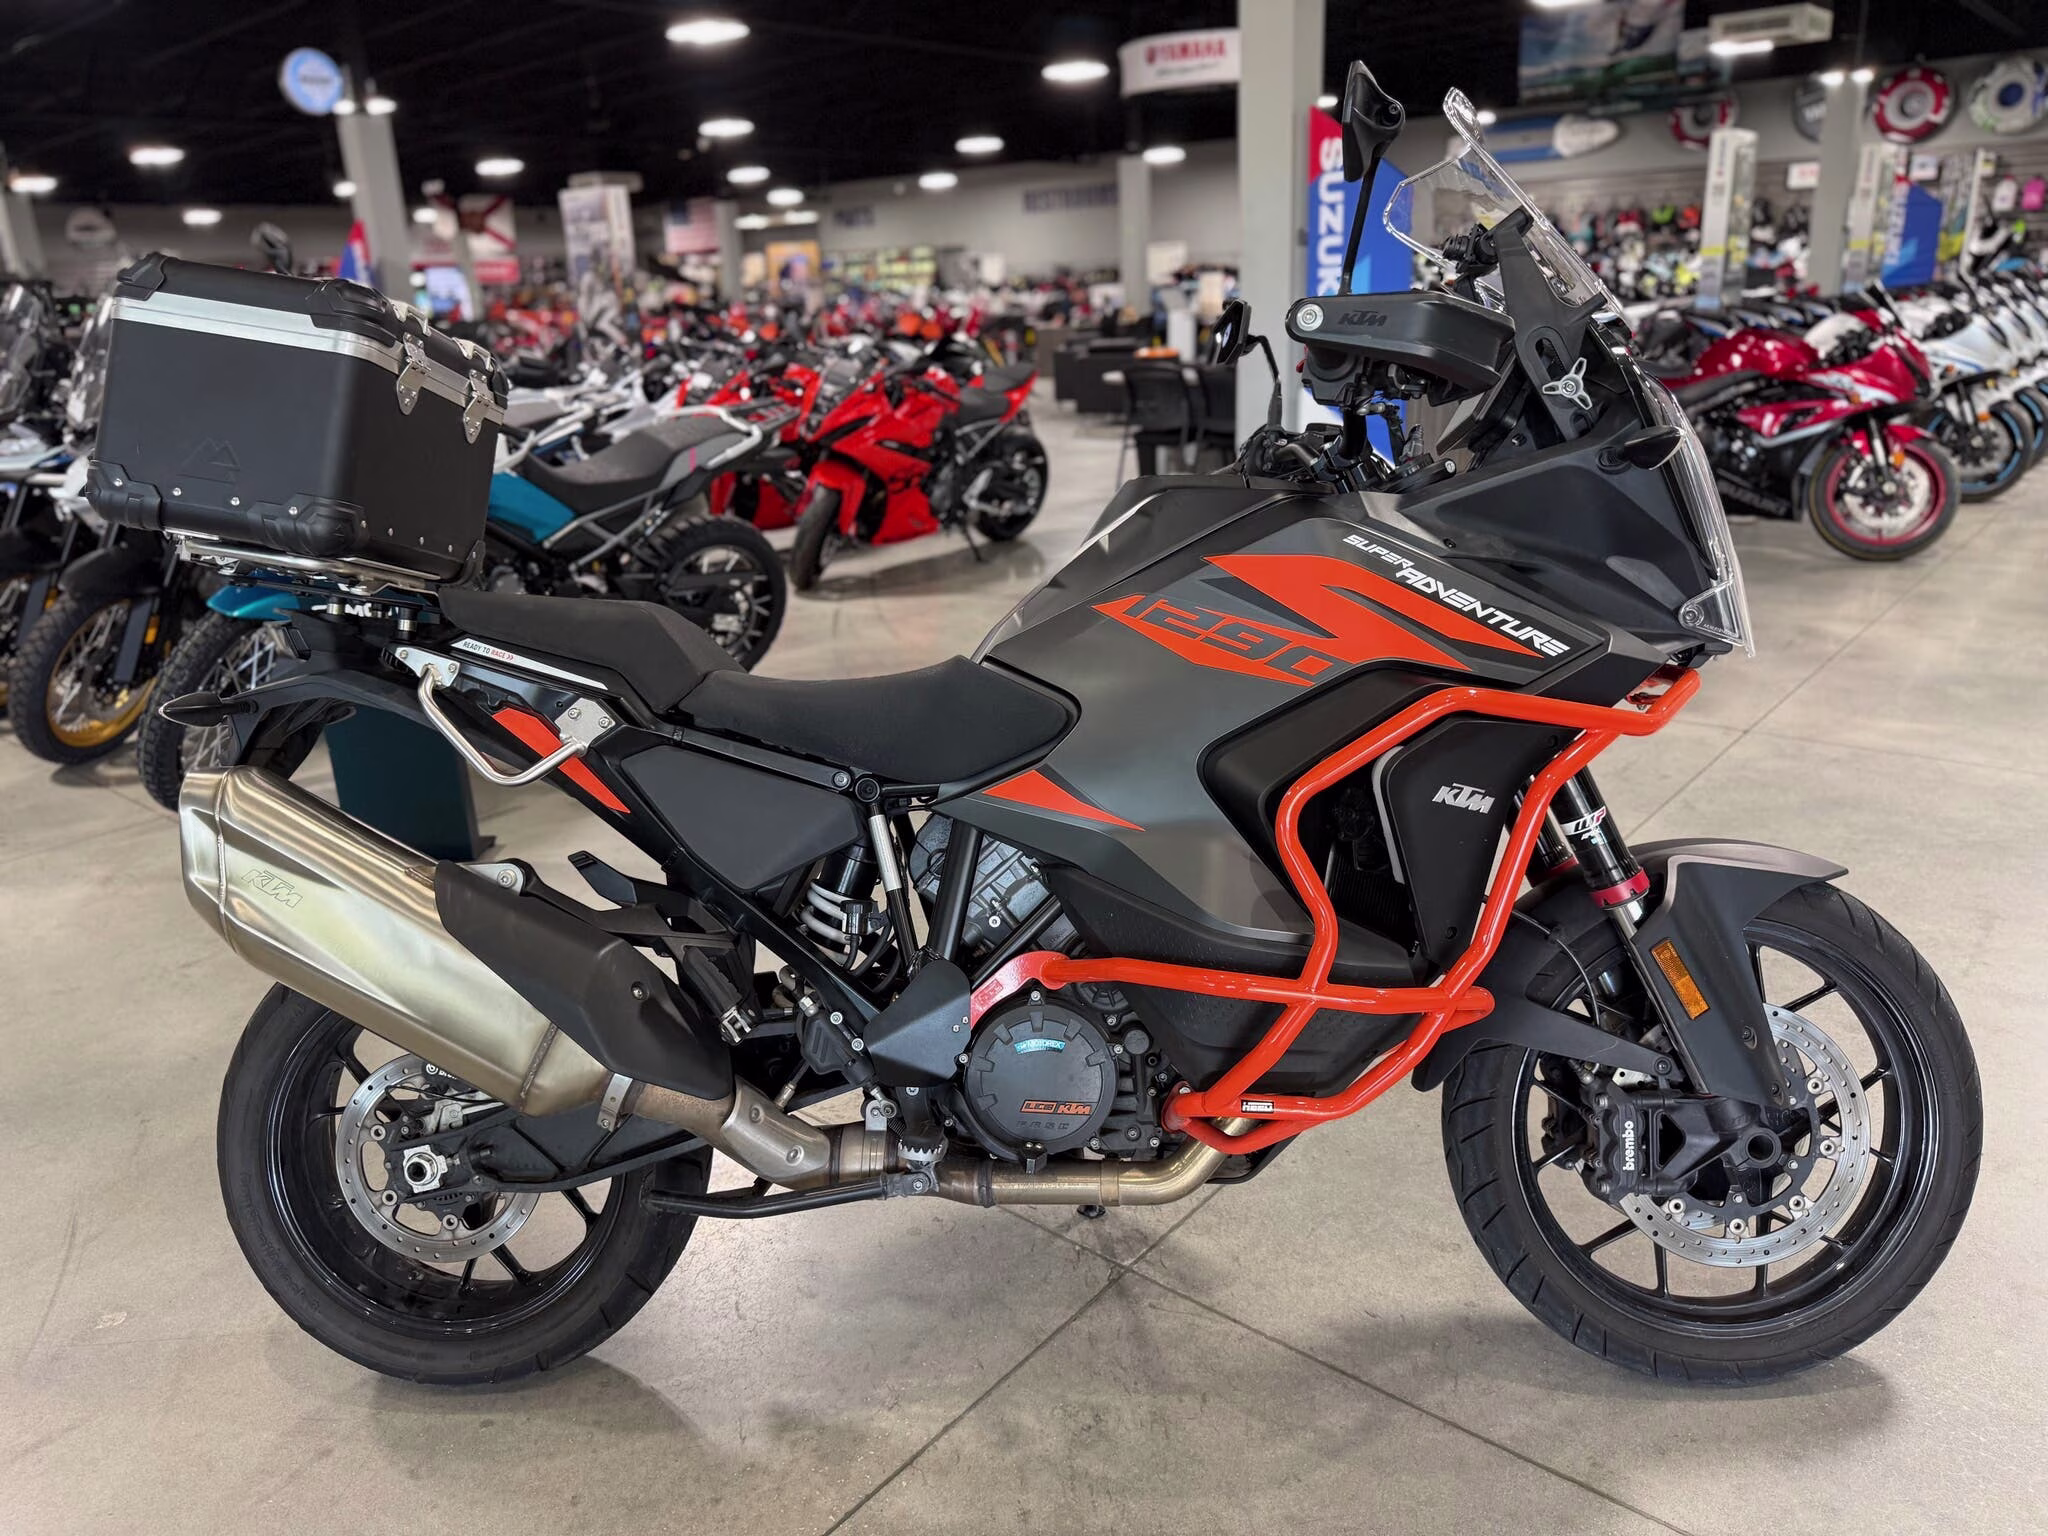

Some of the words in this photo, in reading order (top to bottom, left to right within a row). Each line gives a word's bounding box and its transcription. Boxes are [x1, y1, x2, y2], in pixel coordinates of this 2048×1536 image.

[1316, 136, 1345, 297] SUZUK
[1338, 309, 1388, 327] KTM
[1342, 534, 1415, 568] SUPER
[1395, 567, 1571, 657] ADVENTURE
[462, 641, 481, 652] READY
[491, 649, 505, 659] RACE
[1122, 595, 1356, 683] 1290
[1431, 782, 1495, 814] KTM
[241, 869, 304, 908] KTM
[1057, 1102, 1092, 1116] KTM
[1621, 1120, 1635, 1171] brembo
